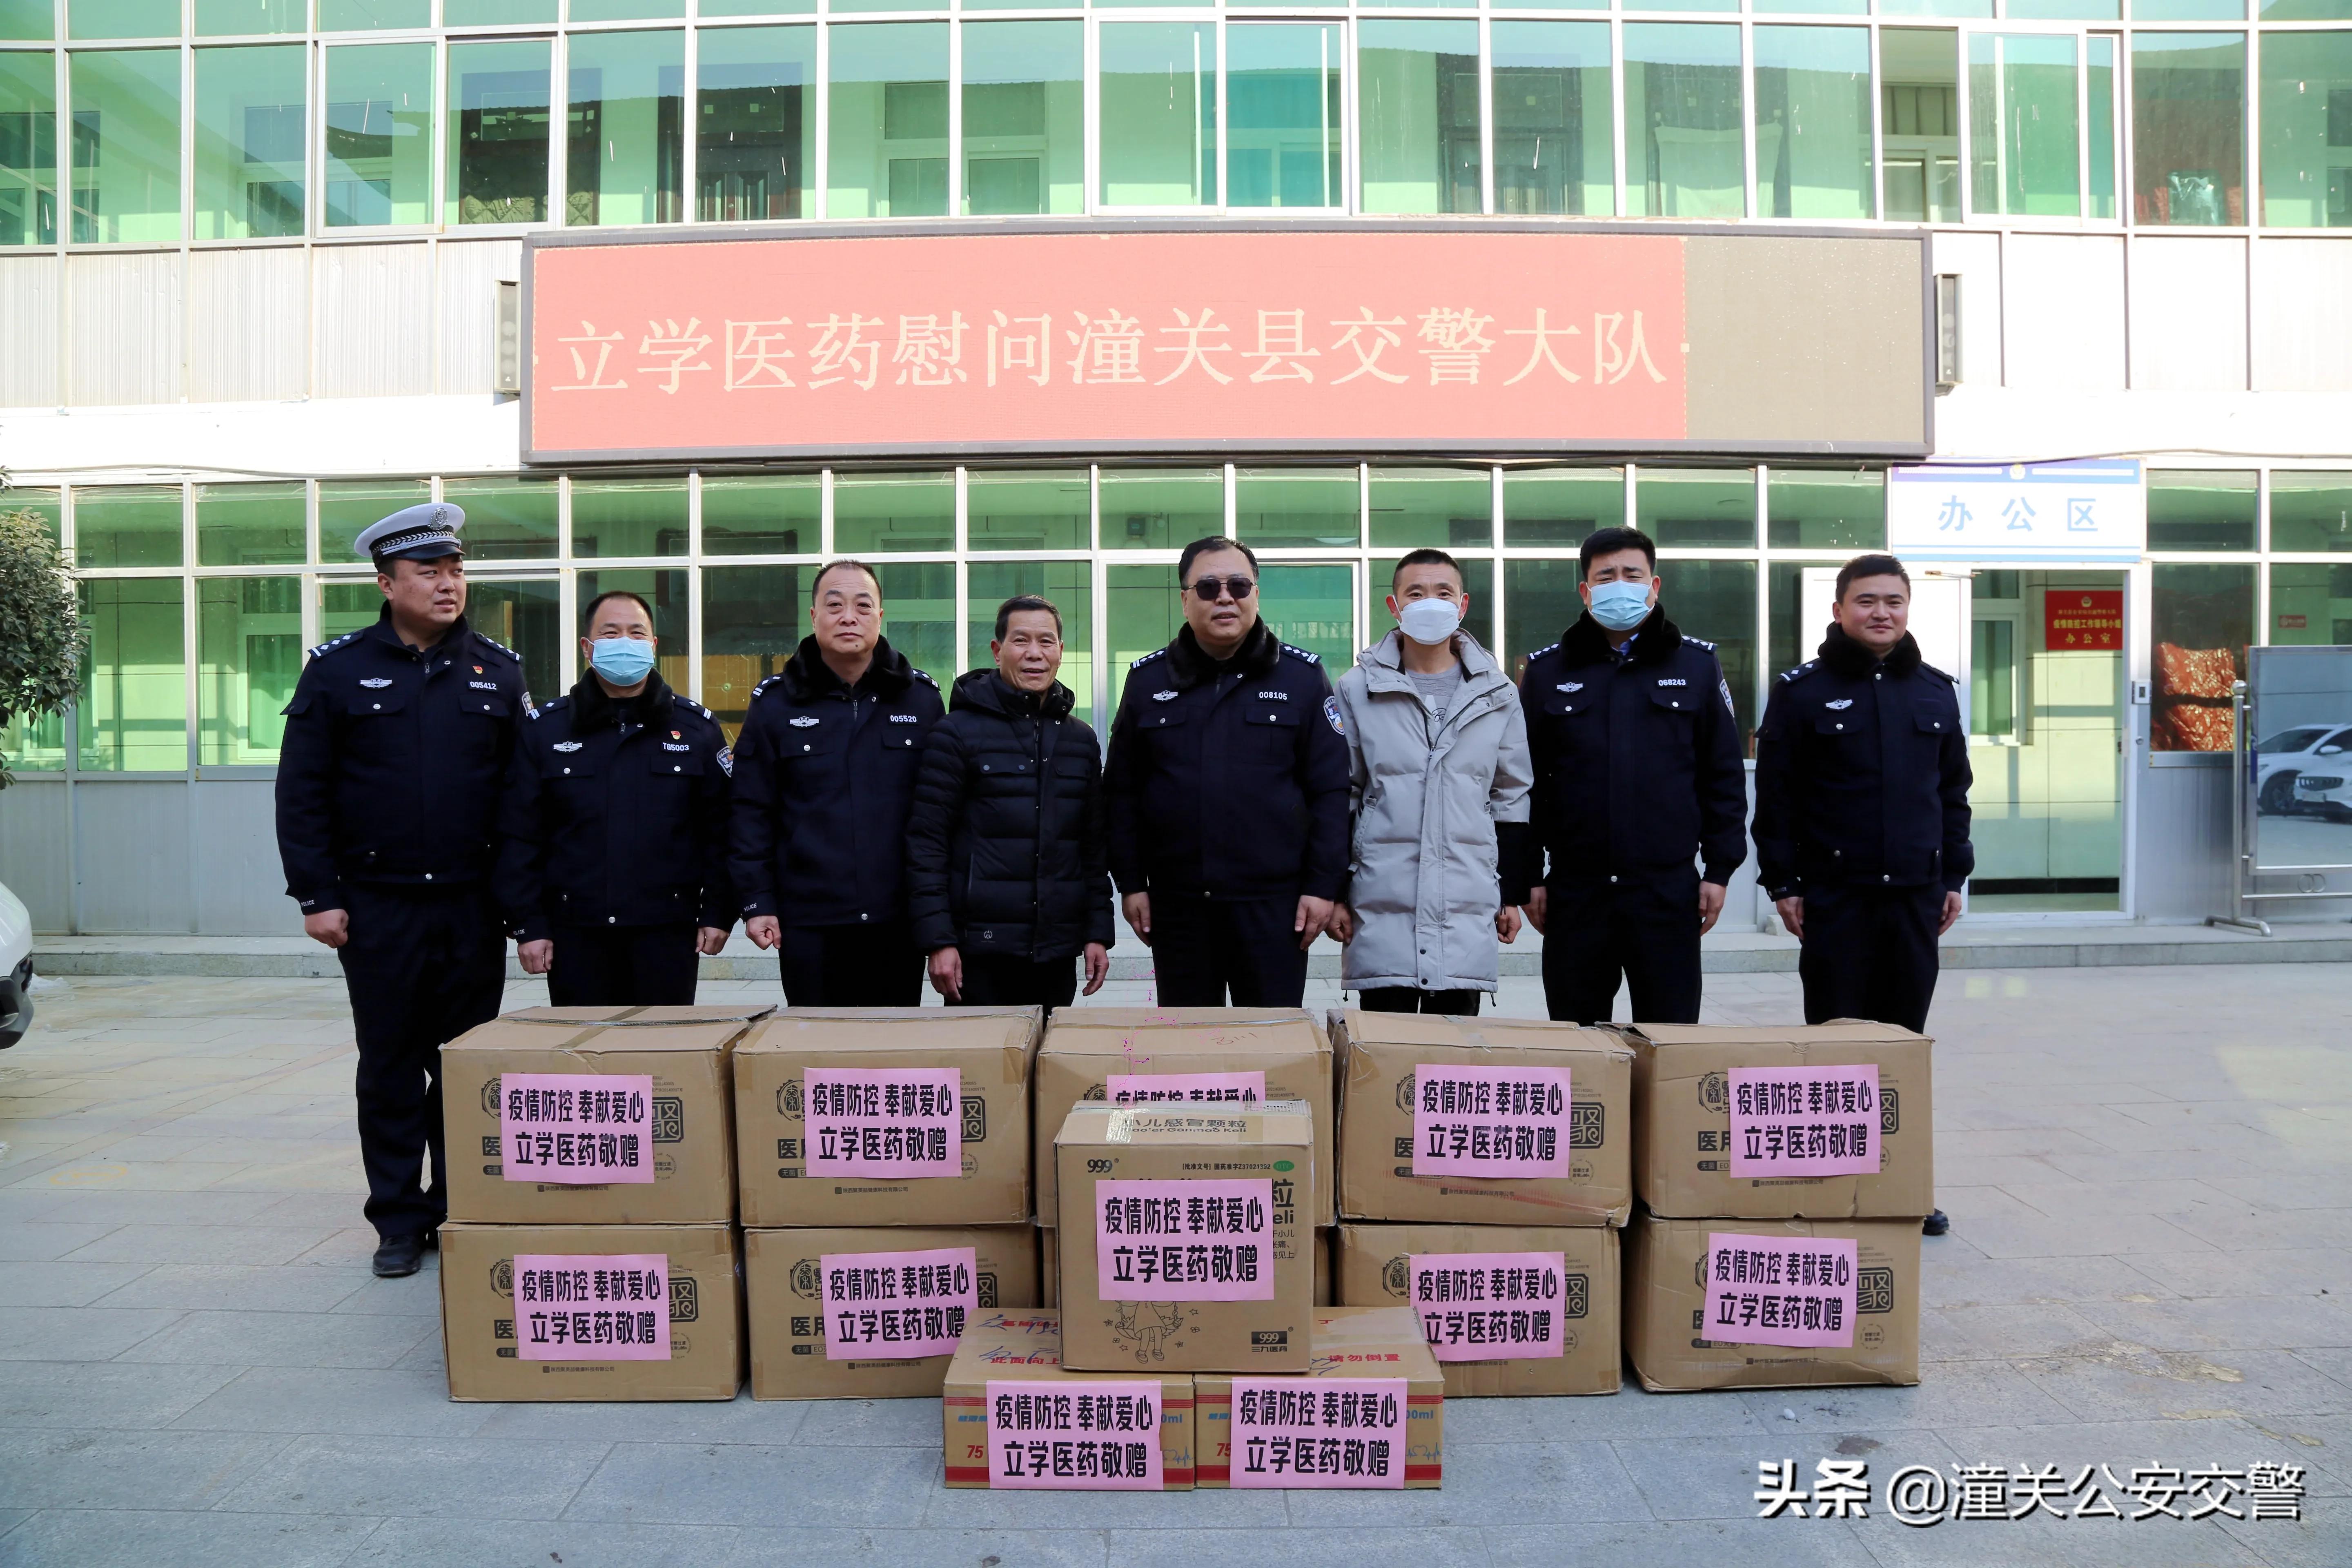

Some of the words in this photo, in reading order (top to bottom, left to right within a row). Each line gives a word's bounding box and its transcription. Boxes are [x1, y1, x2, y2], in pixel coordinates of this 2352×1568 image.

[550, 305, 1668, 395] 立学医药慰问潼关县交警大队
[1938, 495, 2098, 532] 办公区
[470, 681, 497, 690] 005412
[1259, 691, 1287, 700] 008105
[662, 742, 689, 751] TG5003
[509, 1089, 573, 1122] 疫情防控
[579, 1091, 644, 1123] 奉献爱心
[813, 1084, 879, 1117] 疫情防控
[885, 1084, 952, 1117] 奉献爱心
[1424, 1080, 1490, 1114] 疫情防控
[1497, 1082, 1563, 1116] 奉献爱心
[1738, 1082, 1802, 1116] 疫情防控
[1809, 1081, 1872, 1114] 奉献爱心
[516, 1132, 639, 1167] 立学医药敬赠
[820, 1127, 947, 1161] 立学医药敬赠
[1428, 1125, 1556, 1161] 立学医药敬赠
[1745, 1124, 1867, 1160] 立学医药敬赠
[1087, 1159, 1113, 1173] 999
[1106, 1198, 1181, 1234] 疫情防控
[1188, 1197, 1264, 1234] 奉献爱心
[1114, 1245, 1257, 1283] 立学医药敬赠
[1717, 1249, 1782, 1284] 疫情防控
[1787, 1253, 1849, 1287] 奉献爱心
[523, 1270, 589, 1302] 疫情防控
[595, 1270, 661, 1301] 奉献爱心
[831, 1268, 897, 1301] 疫情防控
[902, 1263, 969, 1298] 奉献爱心
[1419, 1270, 1485, 1302] 疫情防控
[1491, 1268, 1557, 1301] 奉献爱心
[494, 1320, 518, 1339] 医
[530, 1312, 655, 1345] 立学医药敬赠
[839, 1306, 965, 1343] 立学医药敬赠
[1425, 1310, 1550, 1345] 立学医药敬赠
[1717, 1293, 1842, 1331] 立学医药敬赠
[1259, 1332, 1279, 1343] 999
[1328, 1354, 1401, 1362] 请勿倒置
[997, 1395, 1071, 1430] 疫情防控
[1078, 1396, 1153, 1431] 奉献爱心
[1241, 1390, 1316, 1426] 疫情防控
[1323, 1392, 1397, 1428] 奉献爱心
[967, 1445, 984, 1459] 75
[1004, 1441, 1147, 1478] 立学医药敬赠
[1245, 1437, 1390, 1477] 立学医药敬赠
